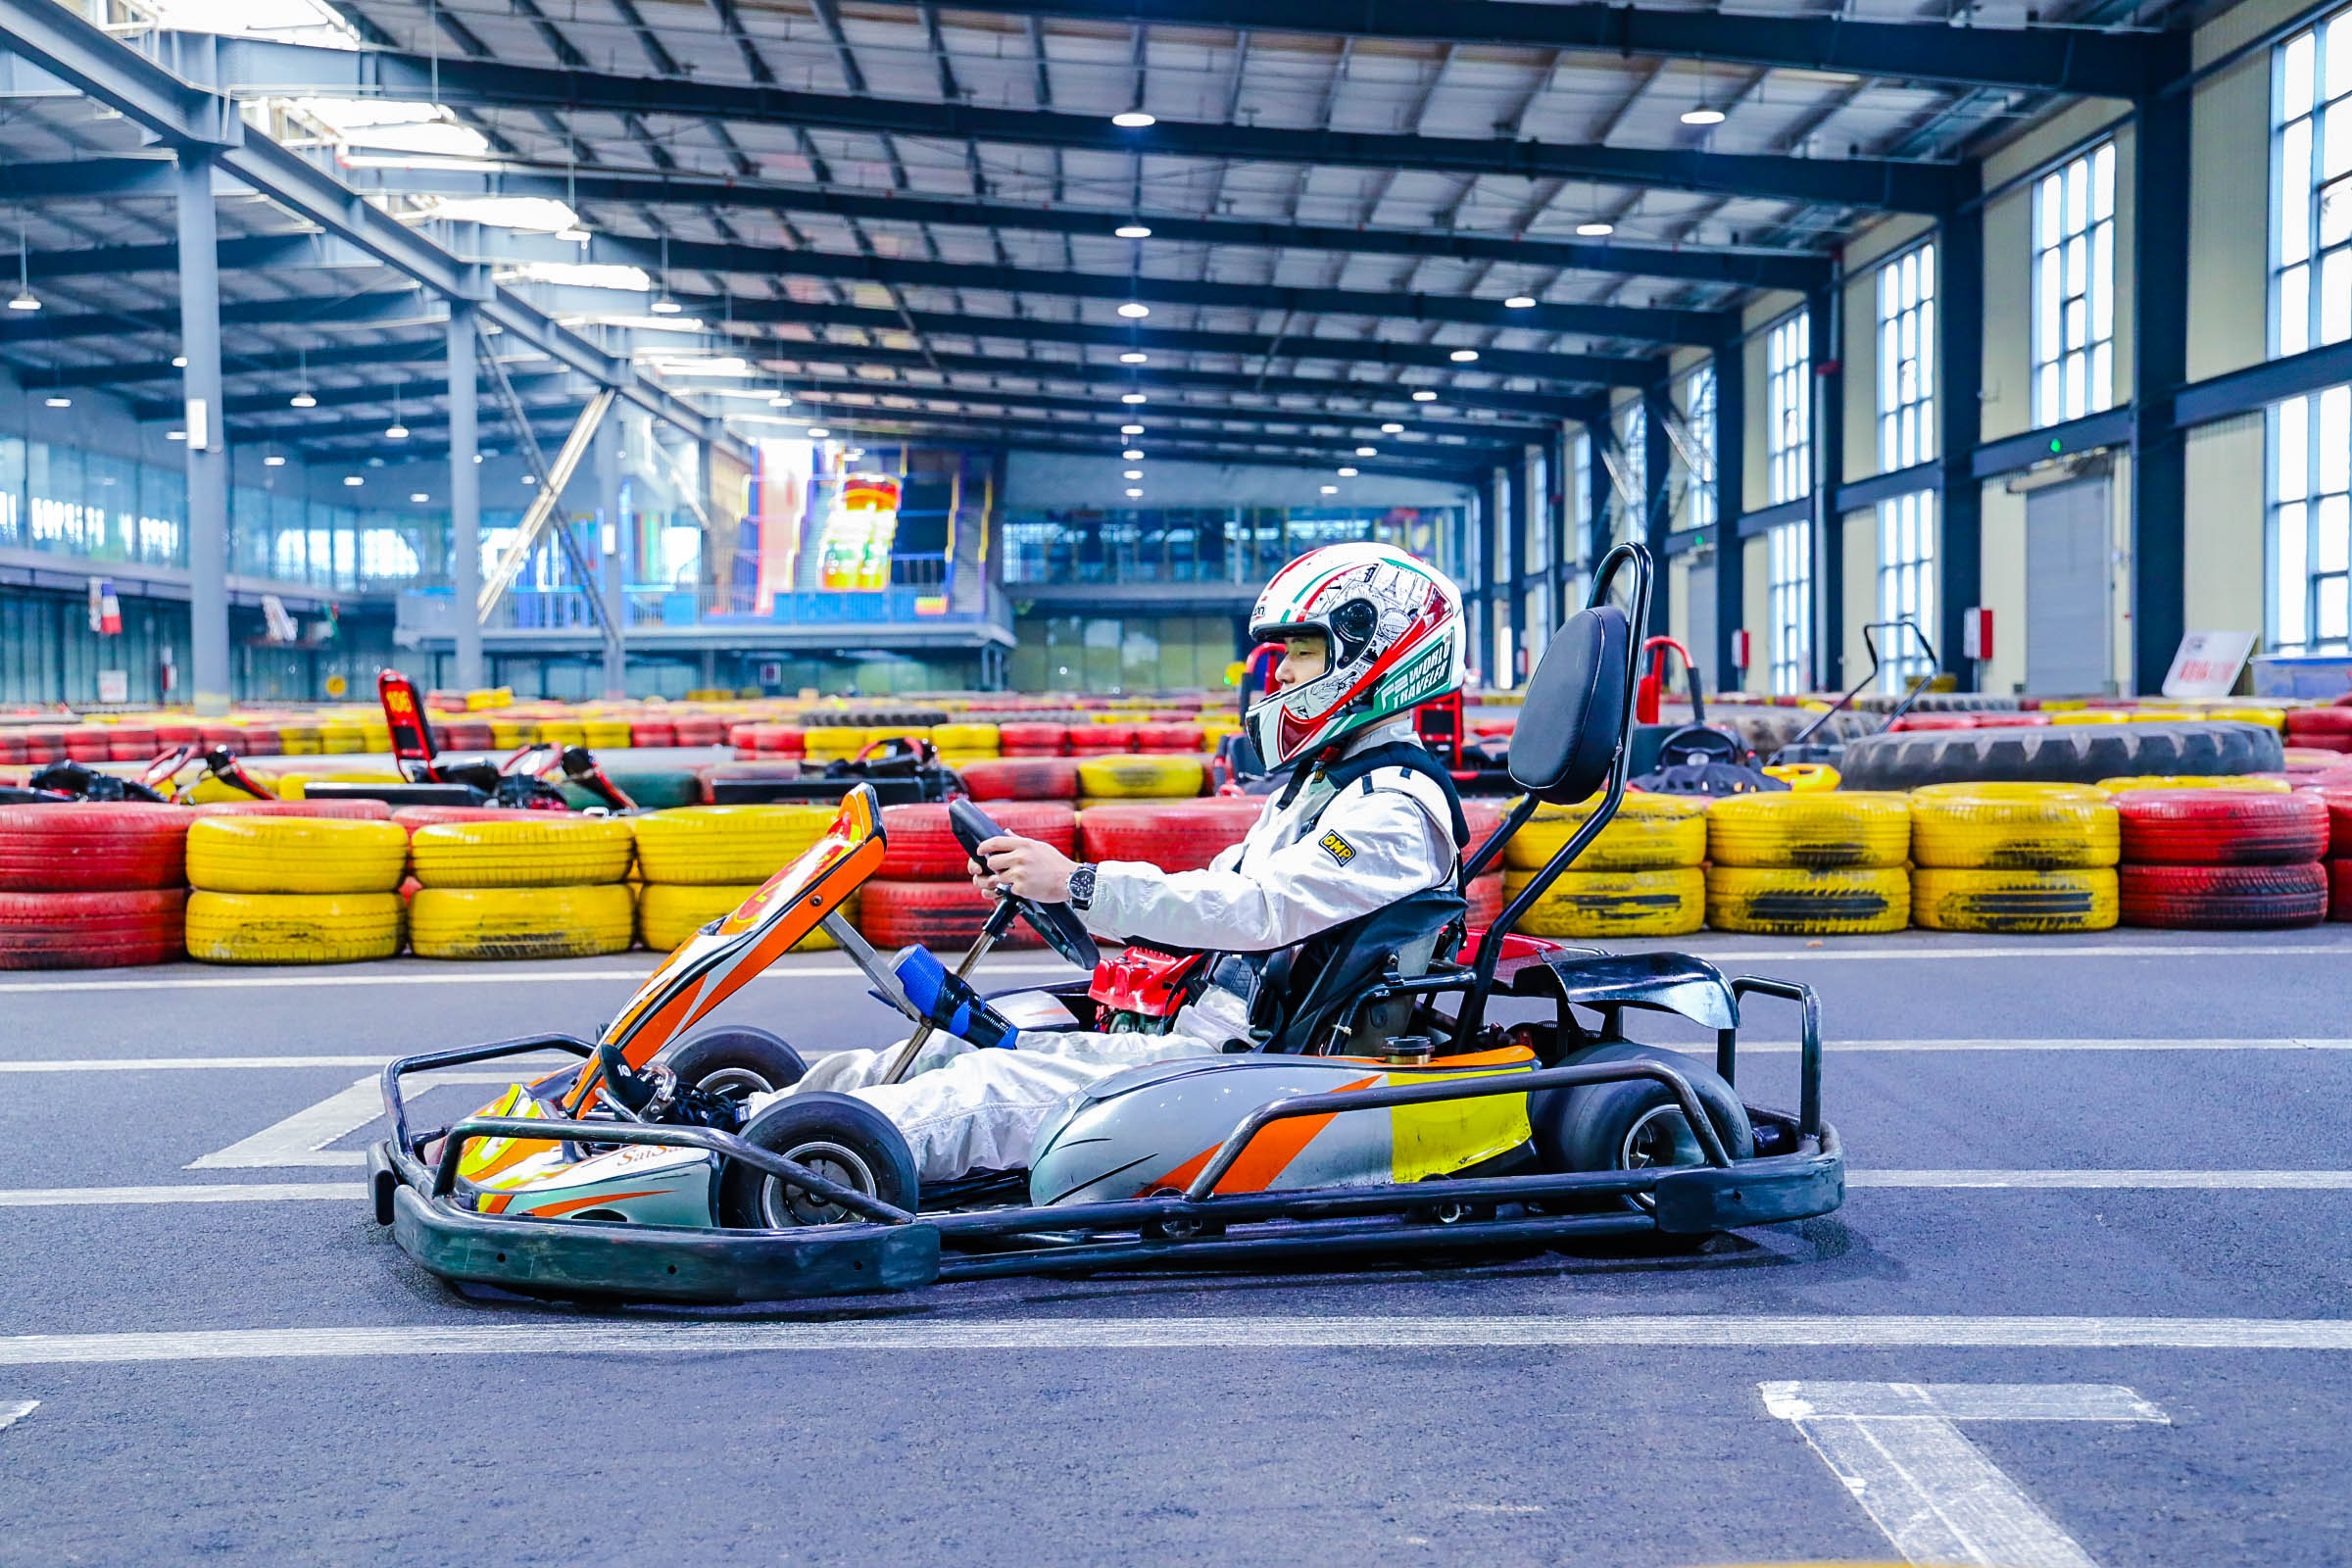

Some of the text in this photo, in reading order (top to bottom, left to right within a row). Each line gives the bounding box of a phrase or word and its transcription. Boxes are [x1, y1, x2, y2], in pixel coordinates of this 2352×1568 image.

[1409, 641, 1451, 684] WORLD
[1393, 660, 1448, 709] TRAVELER
[1324, 835, 1352, 858] OMP
